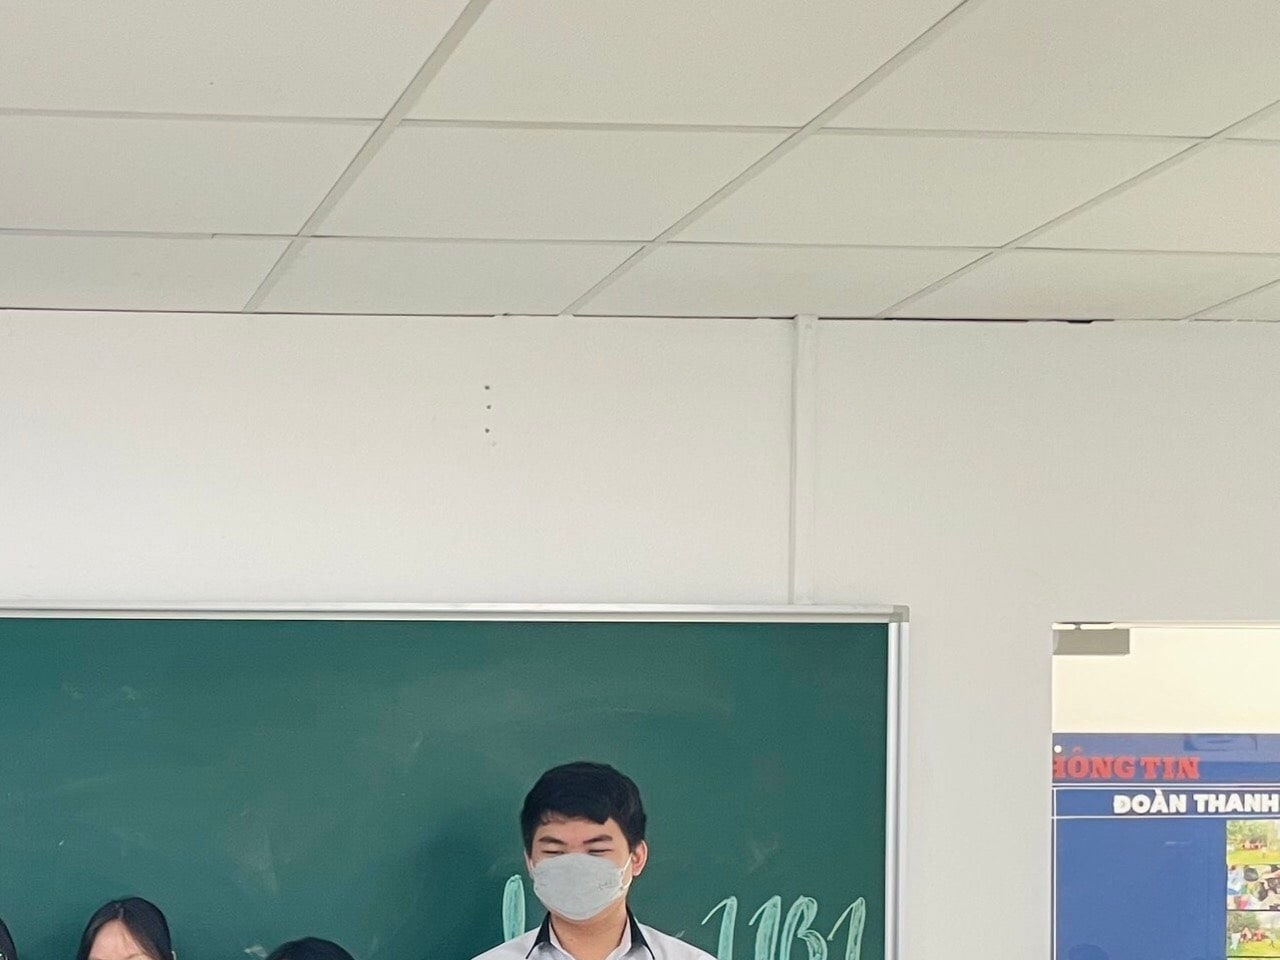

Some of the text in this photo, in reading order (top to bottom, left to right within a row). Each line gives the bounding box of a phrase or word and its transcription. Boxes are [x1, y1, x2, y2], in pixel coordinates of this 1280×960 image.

[1140, 756, 1200, 780] TIN
[1113, 788, 1279, 814] ĐOÀN THANH
